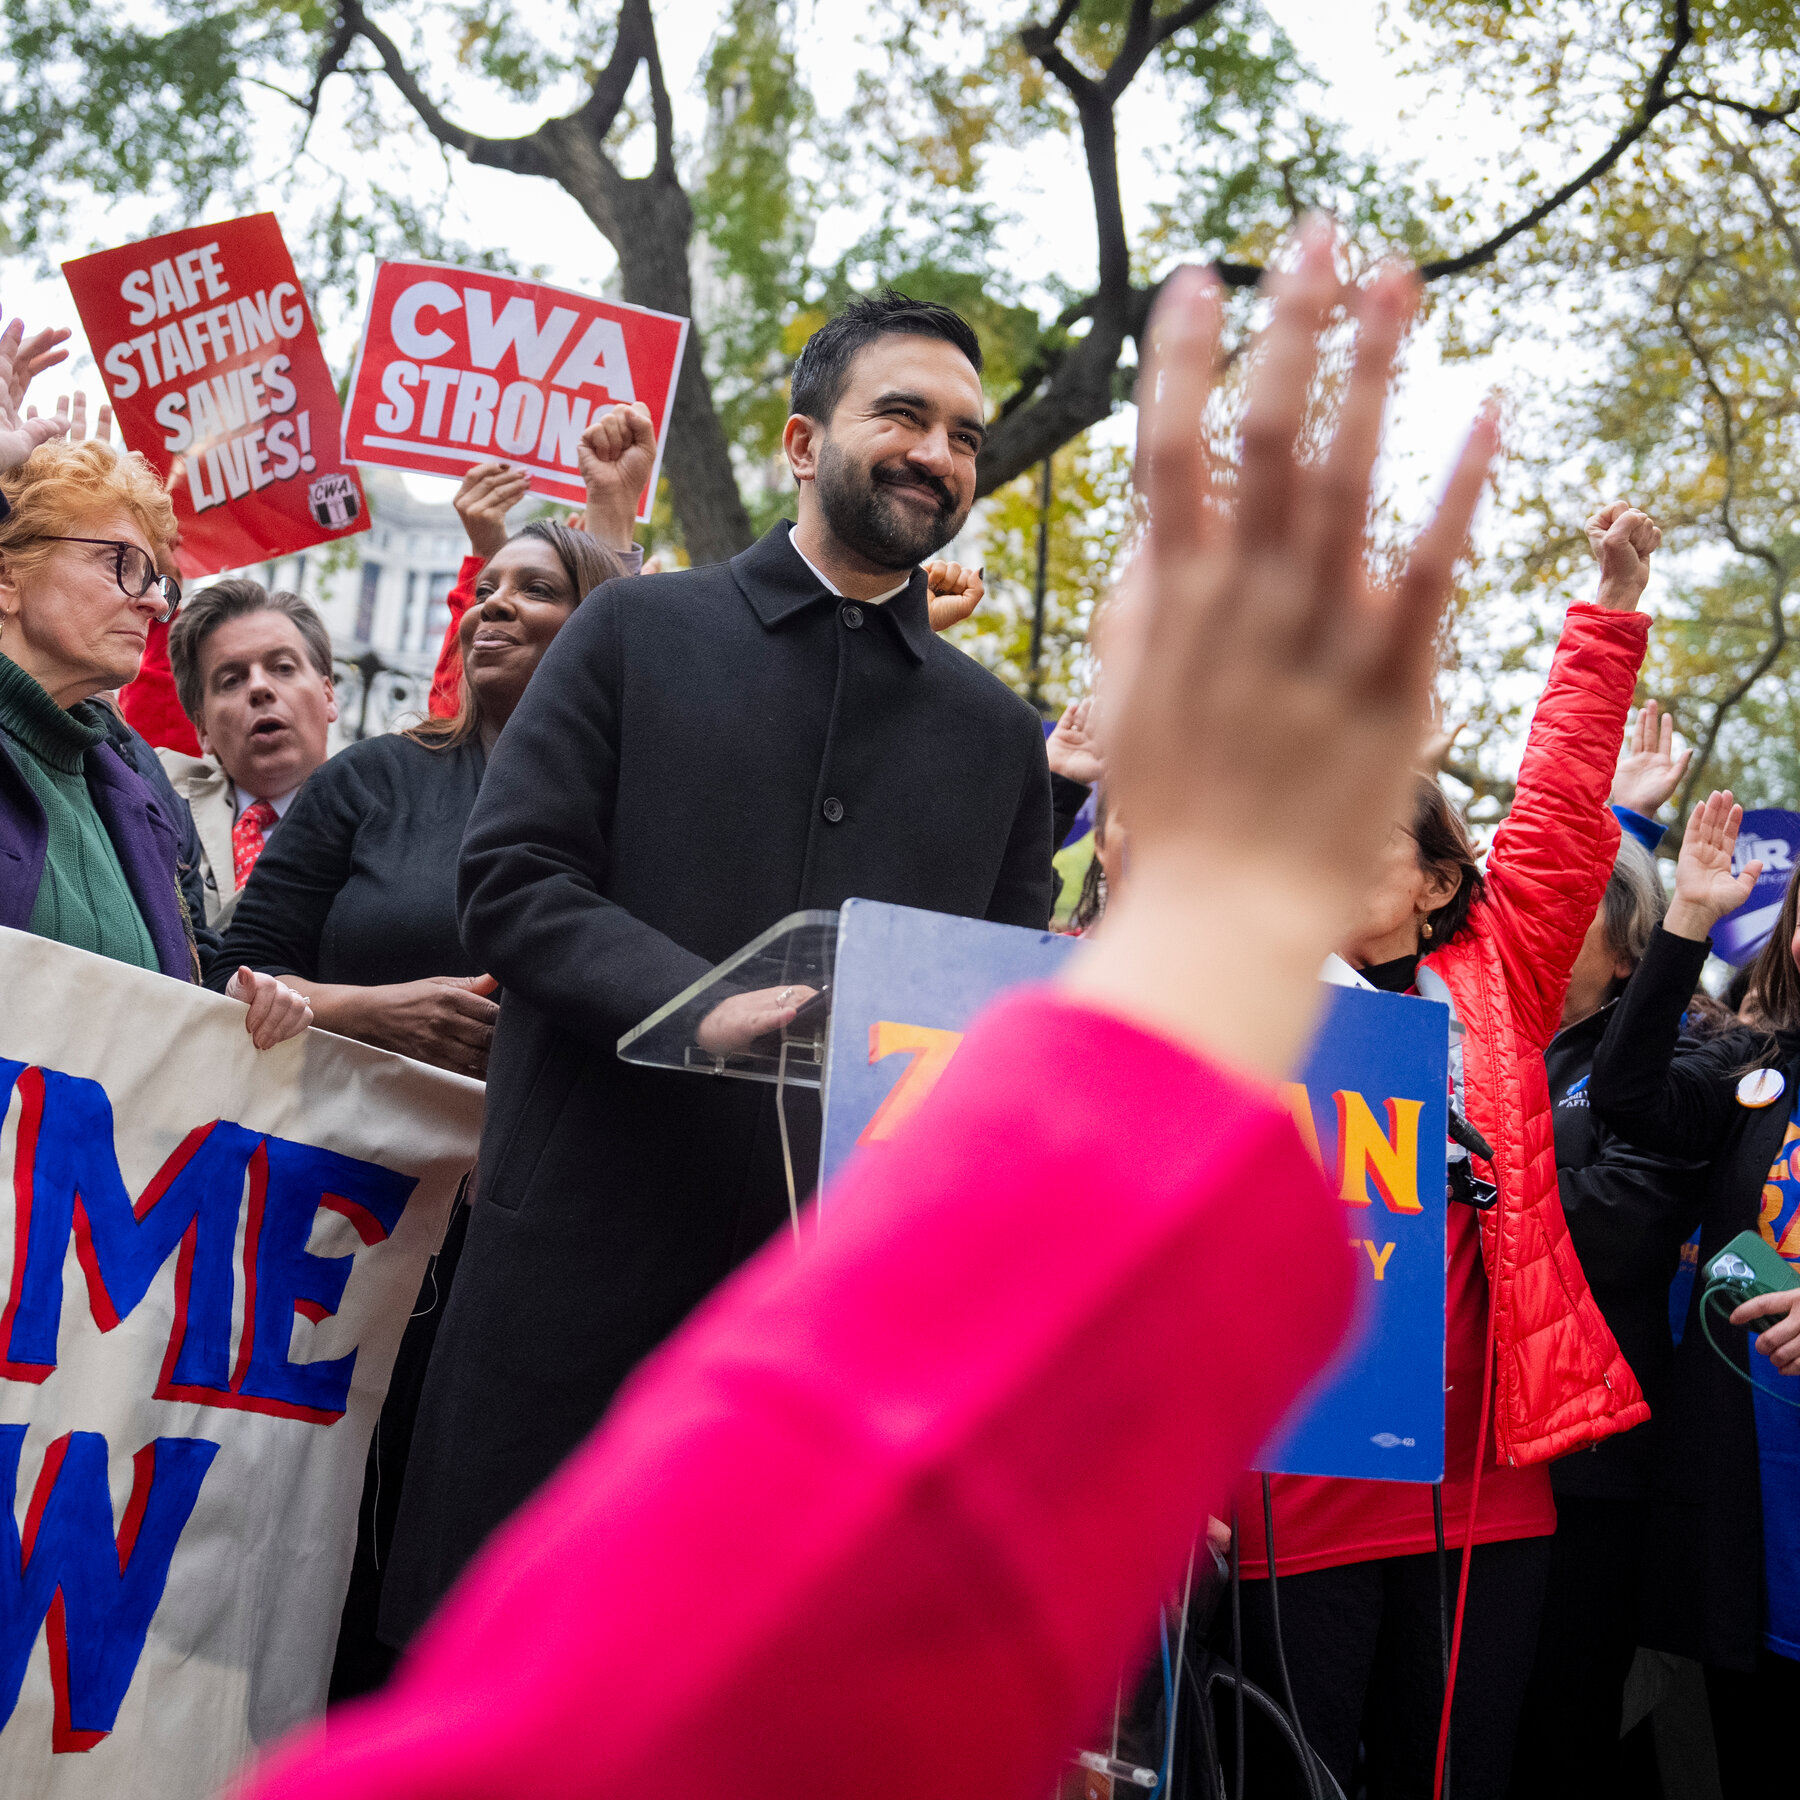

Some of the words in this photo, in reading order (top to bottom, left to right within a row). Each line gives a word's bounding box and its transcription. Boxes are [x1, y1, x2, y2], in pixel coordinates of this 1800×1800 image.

[120, 241, 230, 326] SAFE
[104, 281, 304, 399] STAFFING
[390, 280, 636, 402] CWA
[155, 353, 297, 454] SAVES
[375, 360, 620, 469] STRON
[185, 410, 316, 514] LIVES!
[314, 479, 348, 501] CWA
